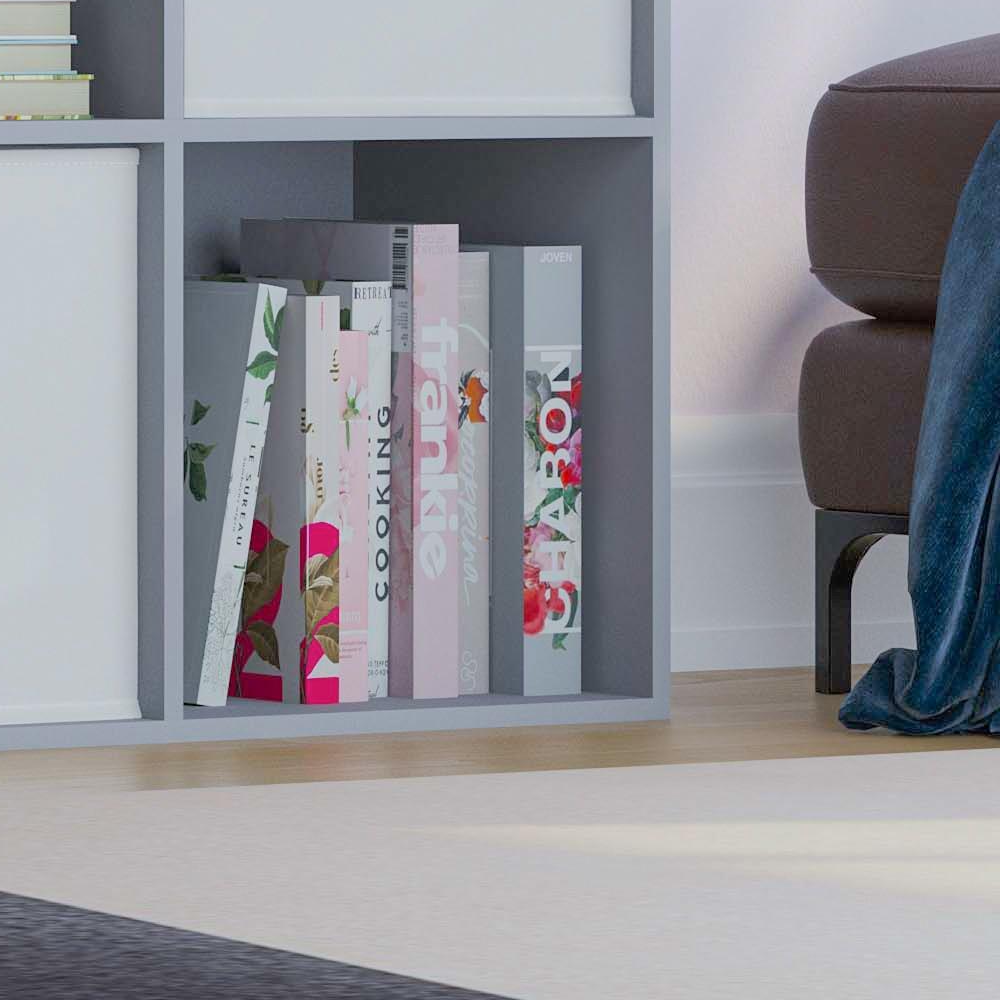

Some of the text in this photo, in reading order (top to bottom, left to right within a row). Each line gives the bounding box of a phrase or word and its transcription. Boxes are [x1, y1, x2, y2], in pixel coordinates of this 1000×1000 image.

[539, 251, 573, 263] JOVEN
[236, 474, 252, 546] SUREAU
[375, 406, 391, 602] COOKING
[419, 317, 459, 580] frankie
[539, 351, 573, 633] CHABON
